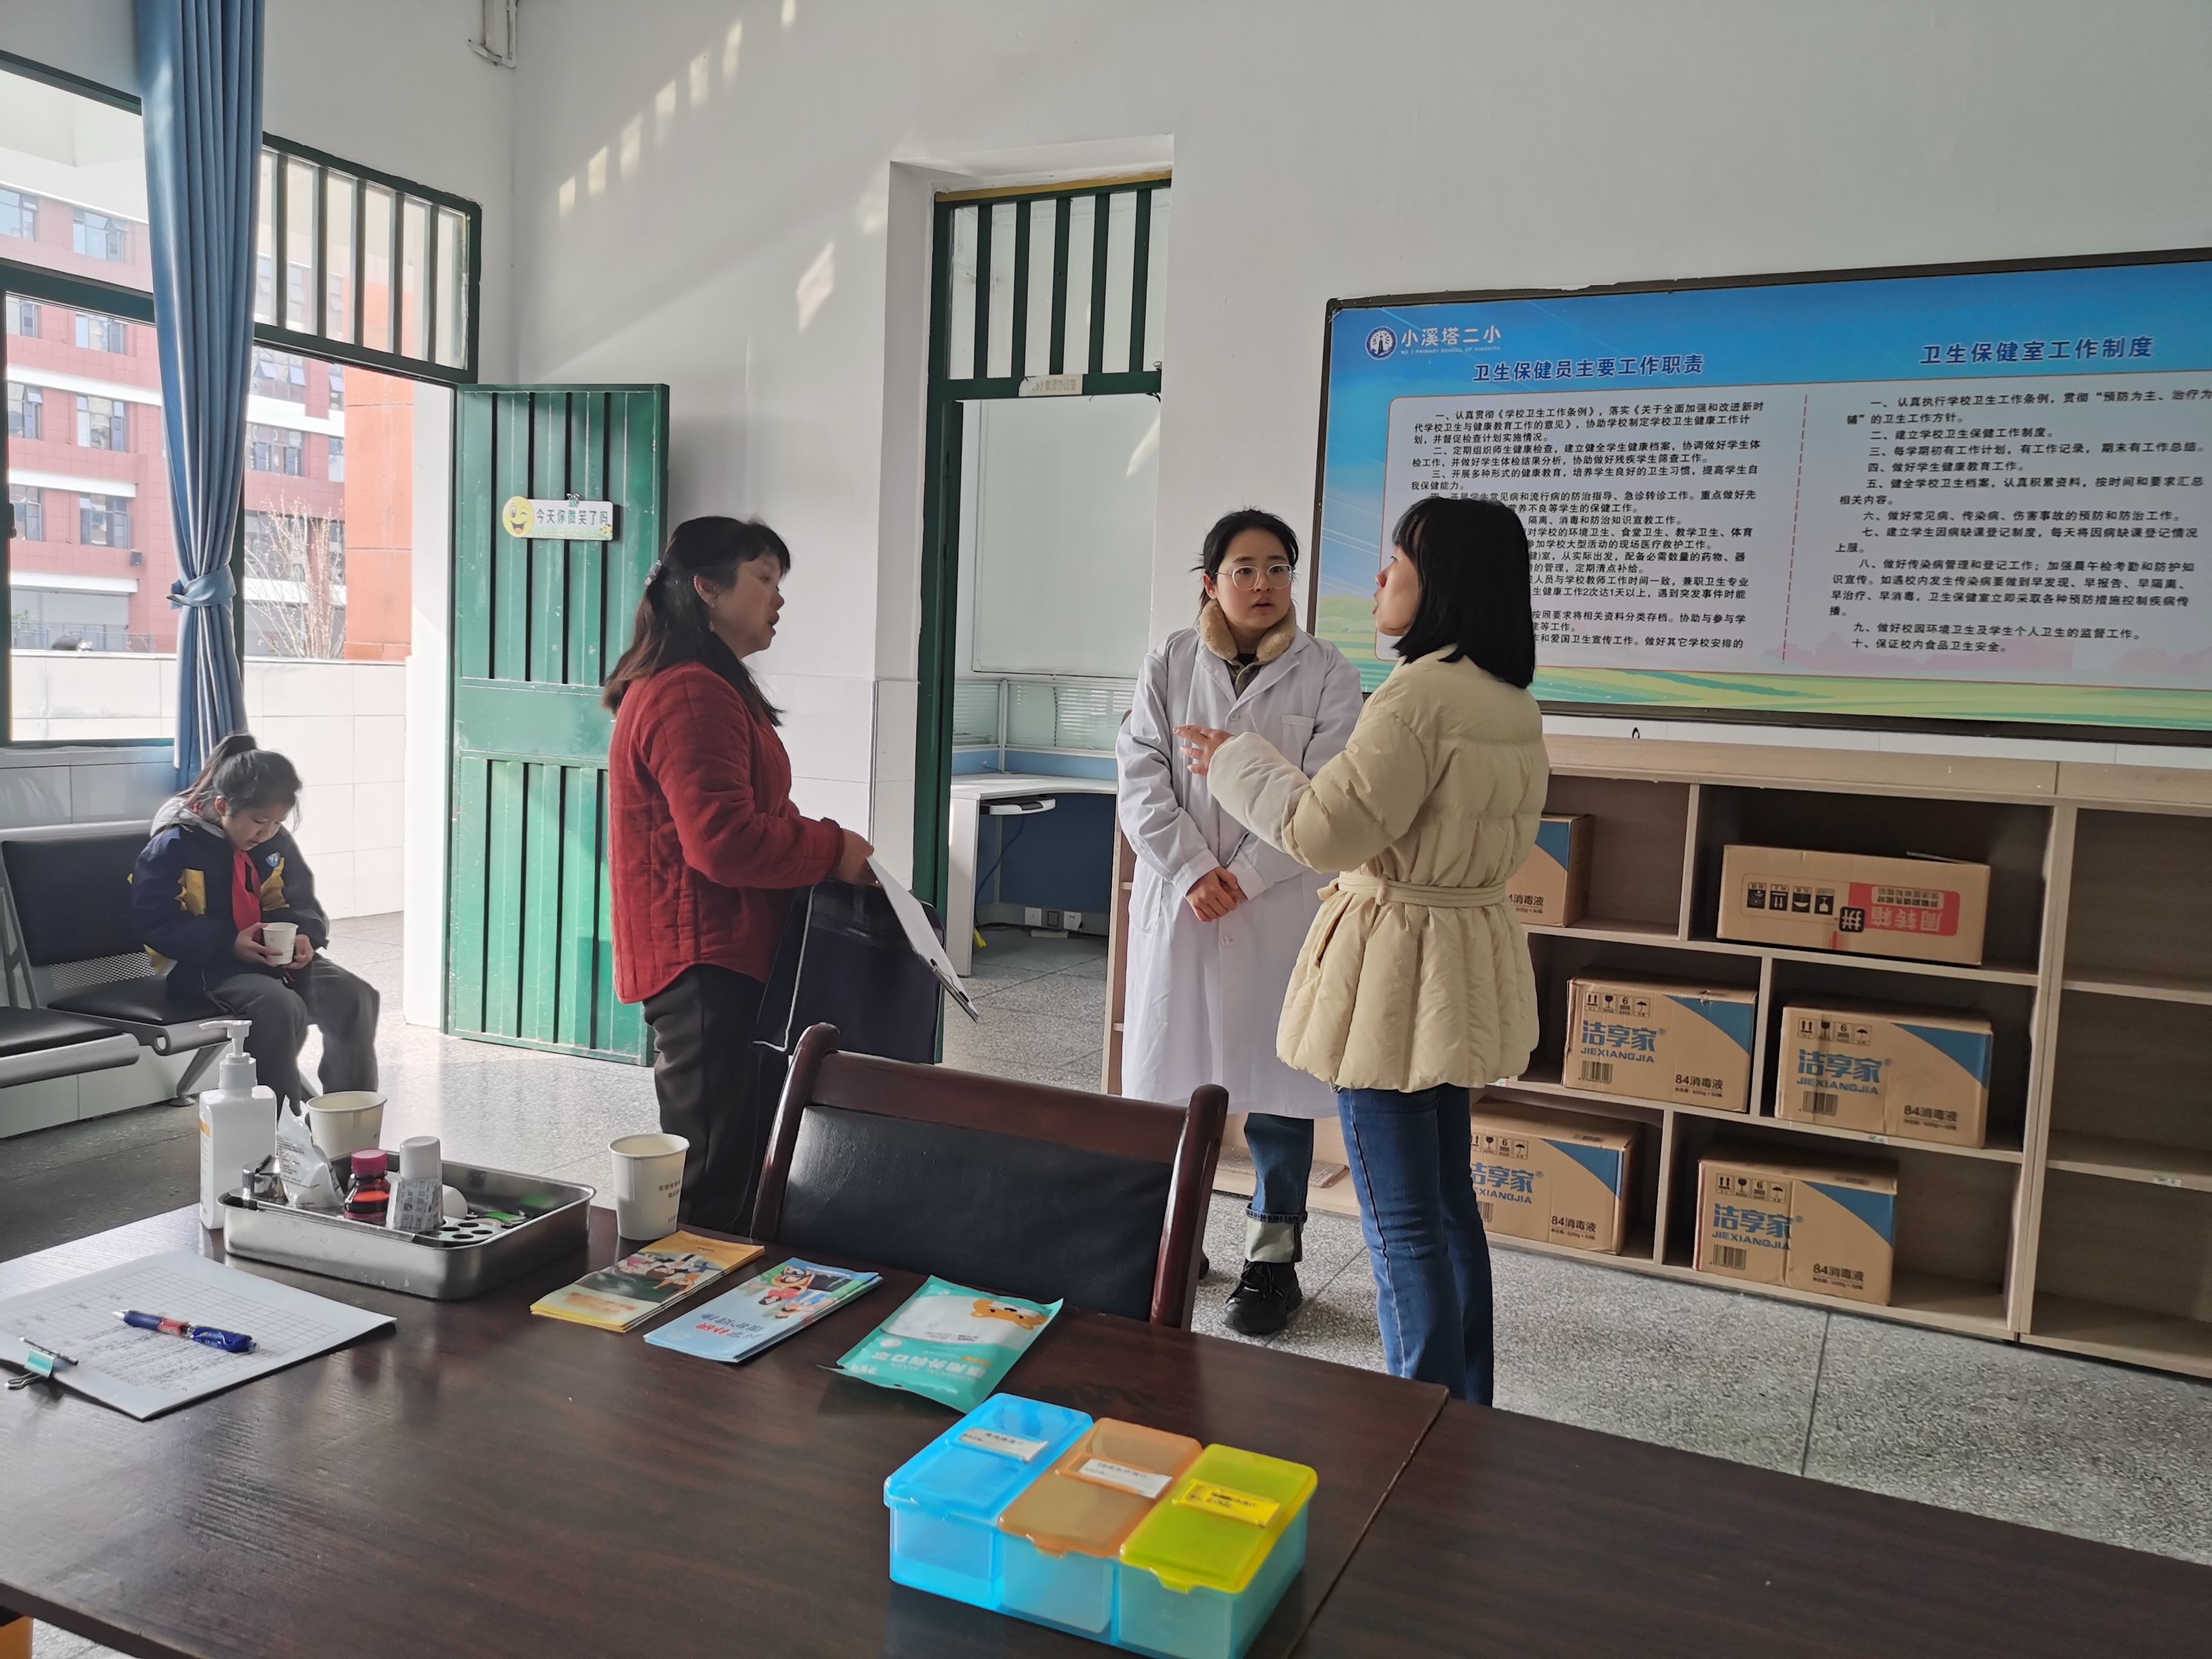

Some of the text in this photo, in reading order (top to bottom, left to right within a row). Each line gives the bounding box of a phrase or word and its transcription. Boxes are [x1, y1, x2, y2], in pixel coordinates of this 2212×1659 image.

[1401, 324, 1501, 347] 小溪塔二小
[1920, 336, 2154, 364] 卫生保健室工作制度
[1473, 354, 1704, 382] 卫生保健员主要工作职责
[1414, 432, 1547, 444] 划，并督促检查计划实施情况。
[1411, 481, 1464, 491] 我保健能力。
[1839, 495, 1893, 505] 相关内容。
[1524, 527, 1752, 537] 对学校的环境卫生、食堂卫生、教学卫生、体育
[1829, 606, 1846, 616] 播。
[1842, 909, 1862, 931] 拼
[1871, 906, 1942, 931] 周转箱
[1581, 1020, 1657, 1052] 洁享家
[1580, 1047, 1654, 1063] JIEXIANGJIA
[1798, 1048, 1881, 1083] 洁享家
[1675, 1074, 1723, 1090] 84消毒液
[1796, 1077, 1879, 1095] JIEXIANGJIA
[1552, 1215, 1596, 1233] 84消毒液
[1714, 1203, 1793, 1239] 洁享家
[1712, 1231, 1791, 1251] JIEXIANGJIA
